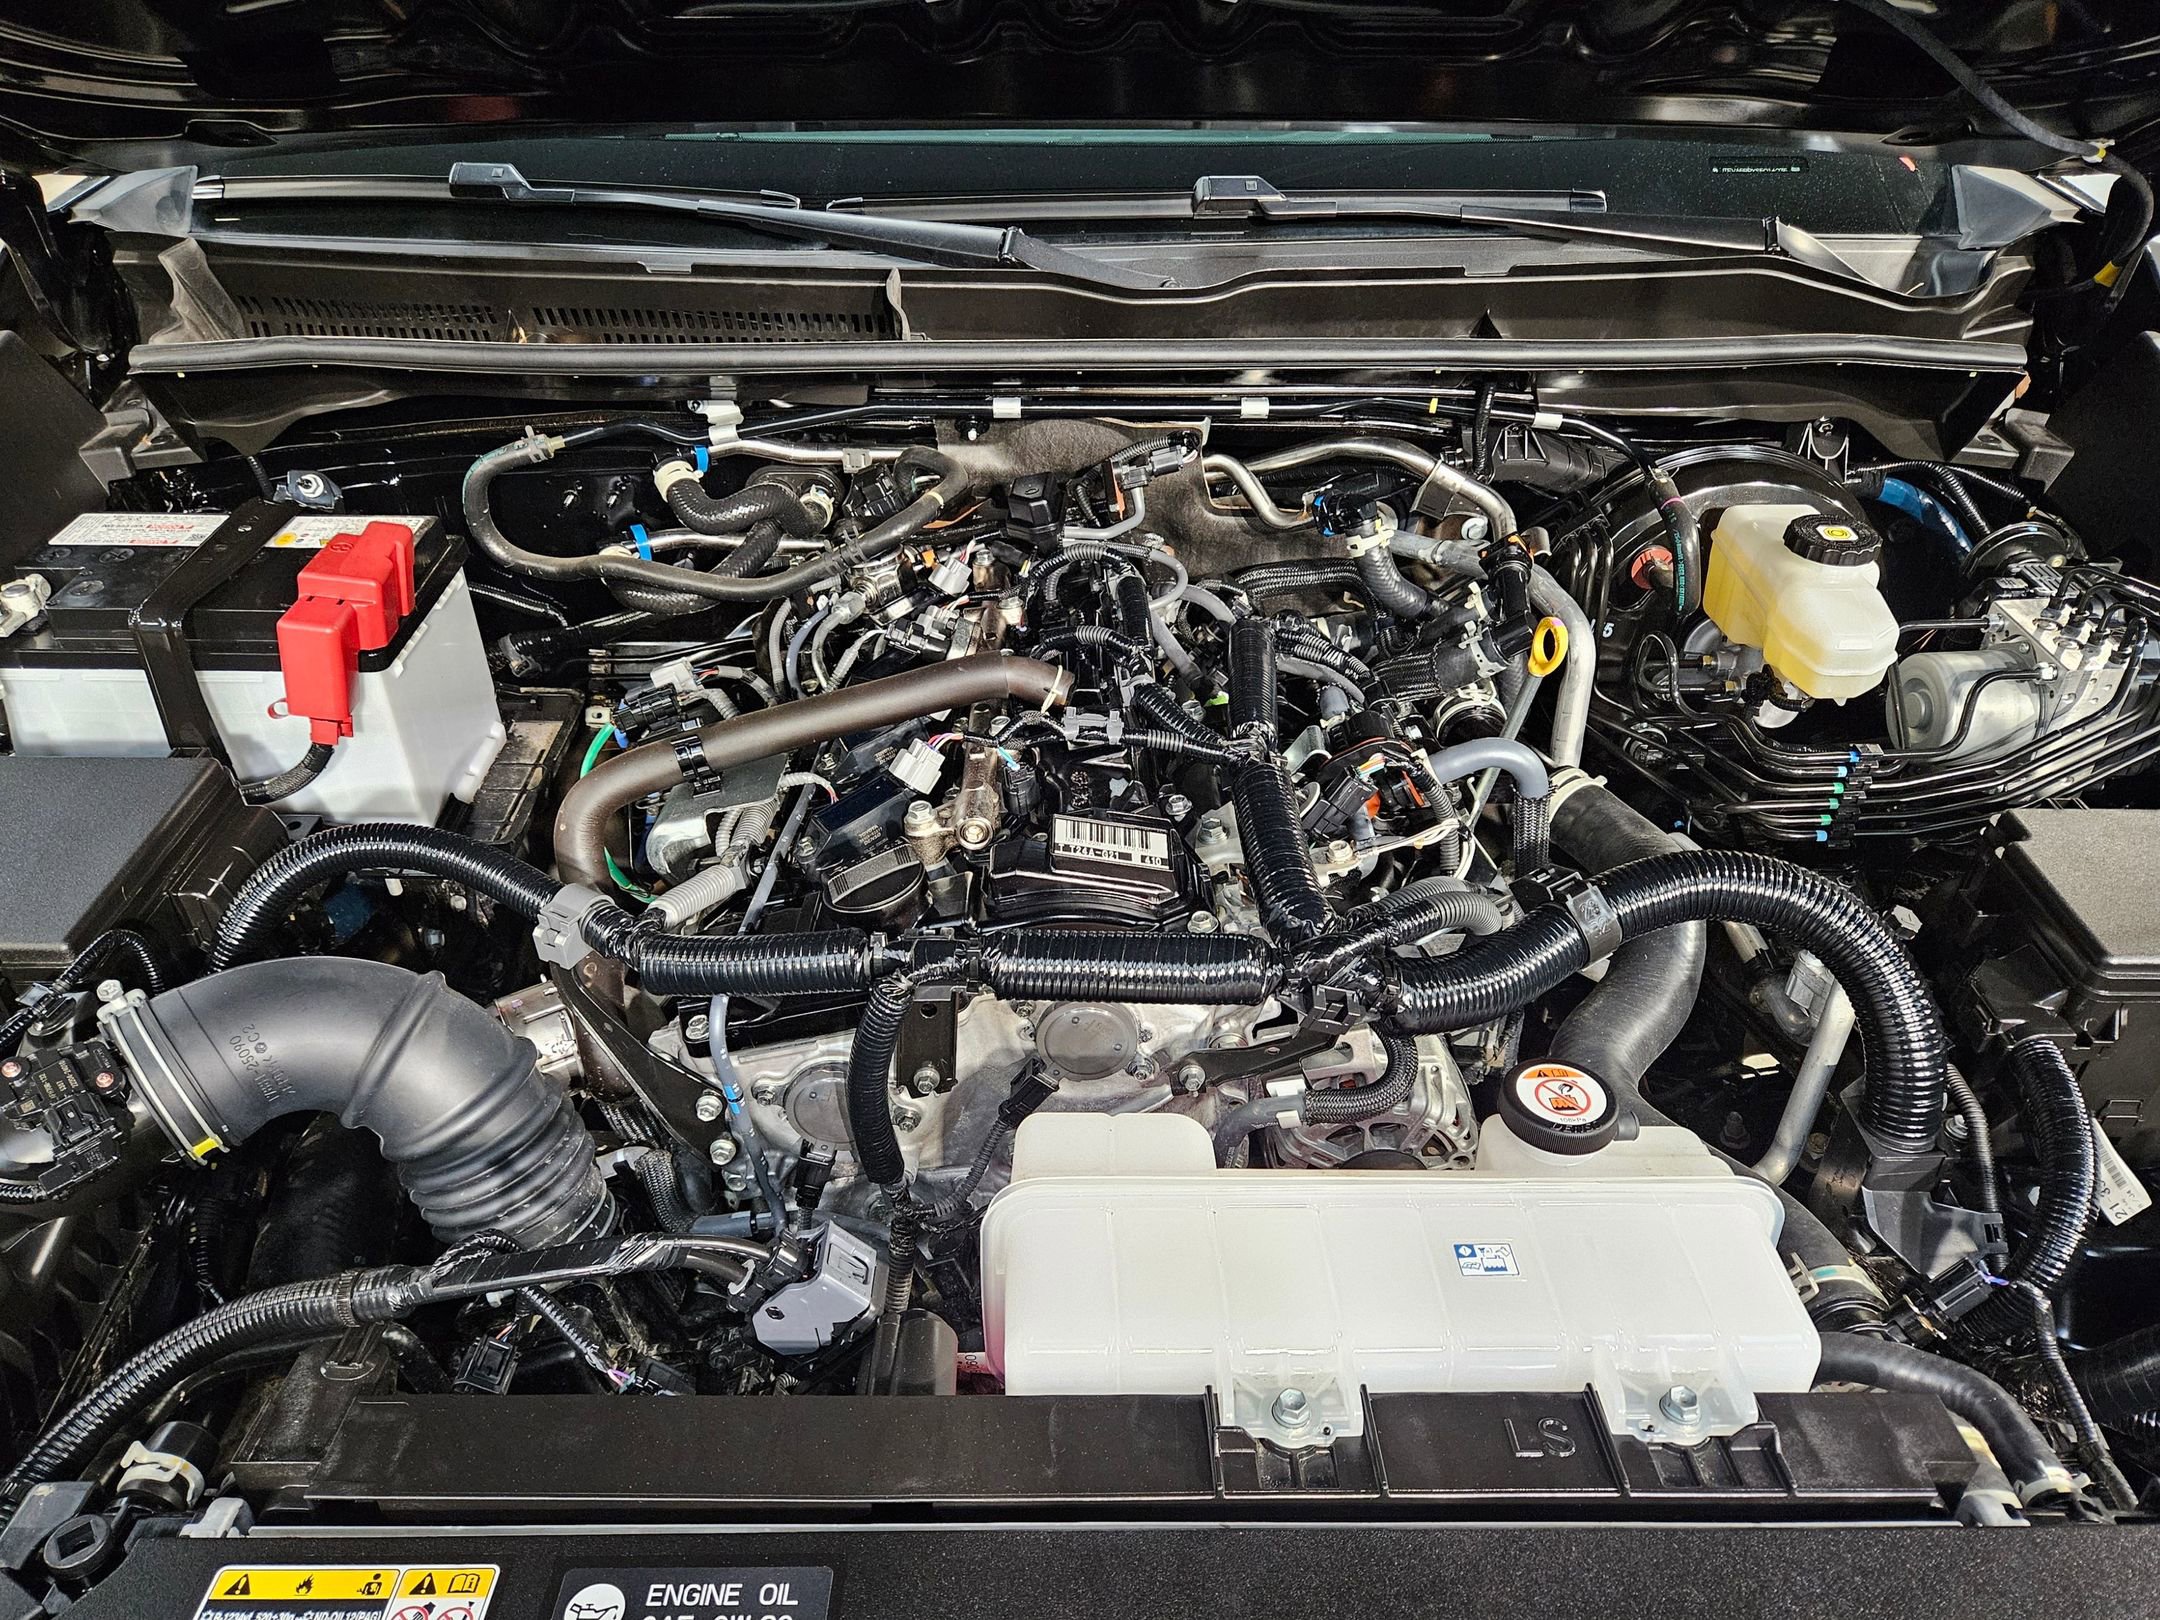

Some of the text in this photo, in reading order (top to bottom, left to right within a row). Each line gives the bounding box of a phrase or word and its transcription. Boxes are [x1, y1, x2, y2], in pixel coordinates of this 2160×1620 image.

[1069, 845, 1120, 860] T24A-G21
[1144, 856, 1162, 866] 410
[1503, 1417, 1576, 1458] LS
[646, 1583, 799, 1607] ENGINE OIL
